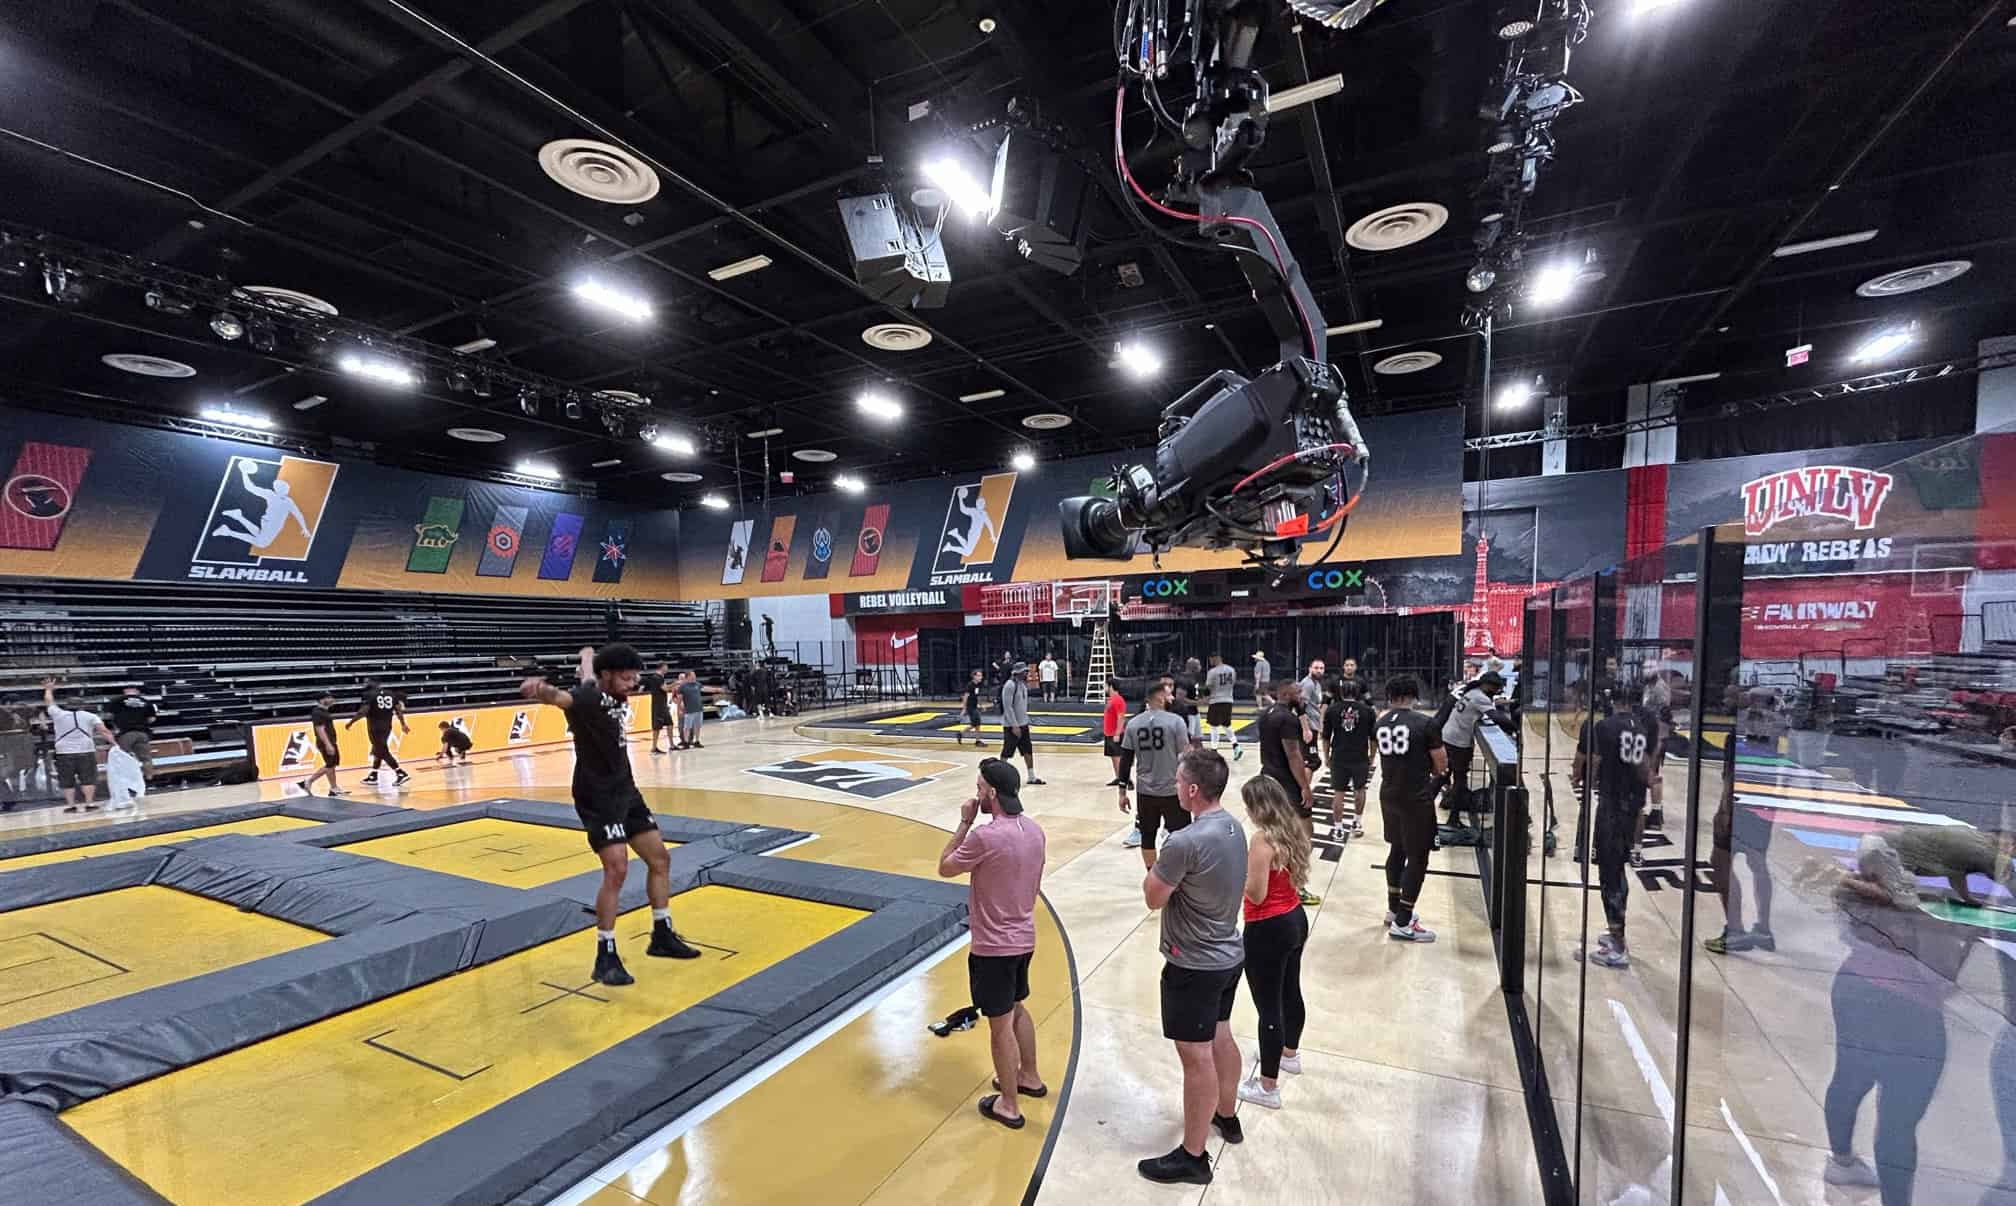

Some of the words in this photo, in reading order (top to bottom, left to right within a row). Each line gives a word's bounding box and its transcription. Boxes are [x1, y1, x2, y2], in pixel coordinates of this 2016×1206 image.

[1741, 465, 1893, 535] UNLV
[188, 566, 308, 582] SLAMBALL
[930, 572, 993, 586] SLAMBALL
[859, 593, 887, 609] REBEL
[889, 590, 947, 607] VOLLEYBALL
[1137, 727, 1164, 750] 28
